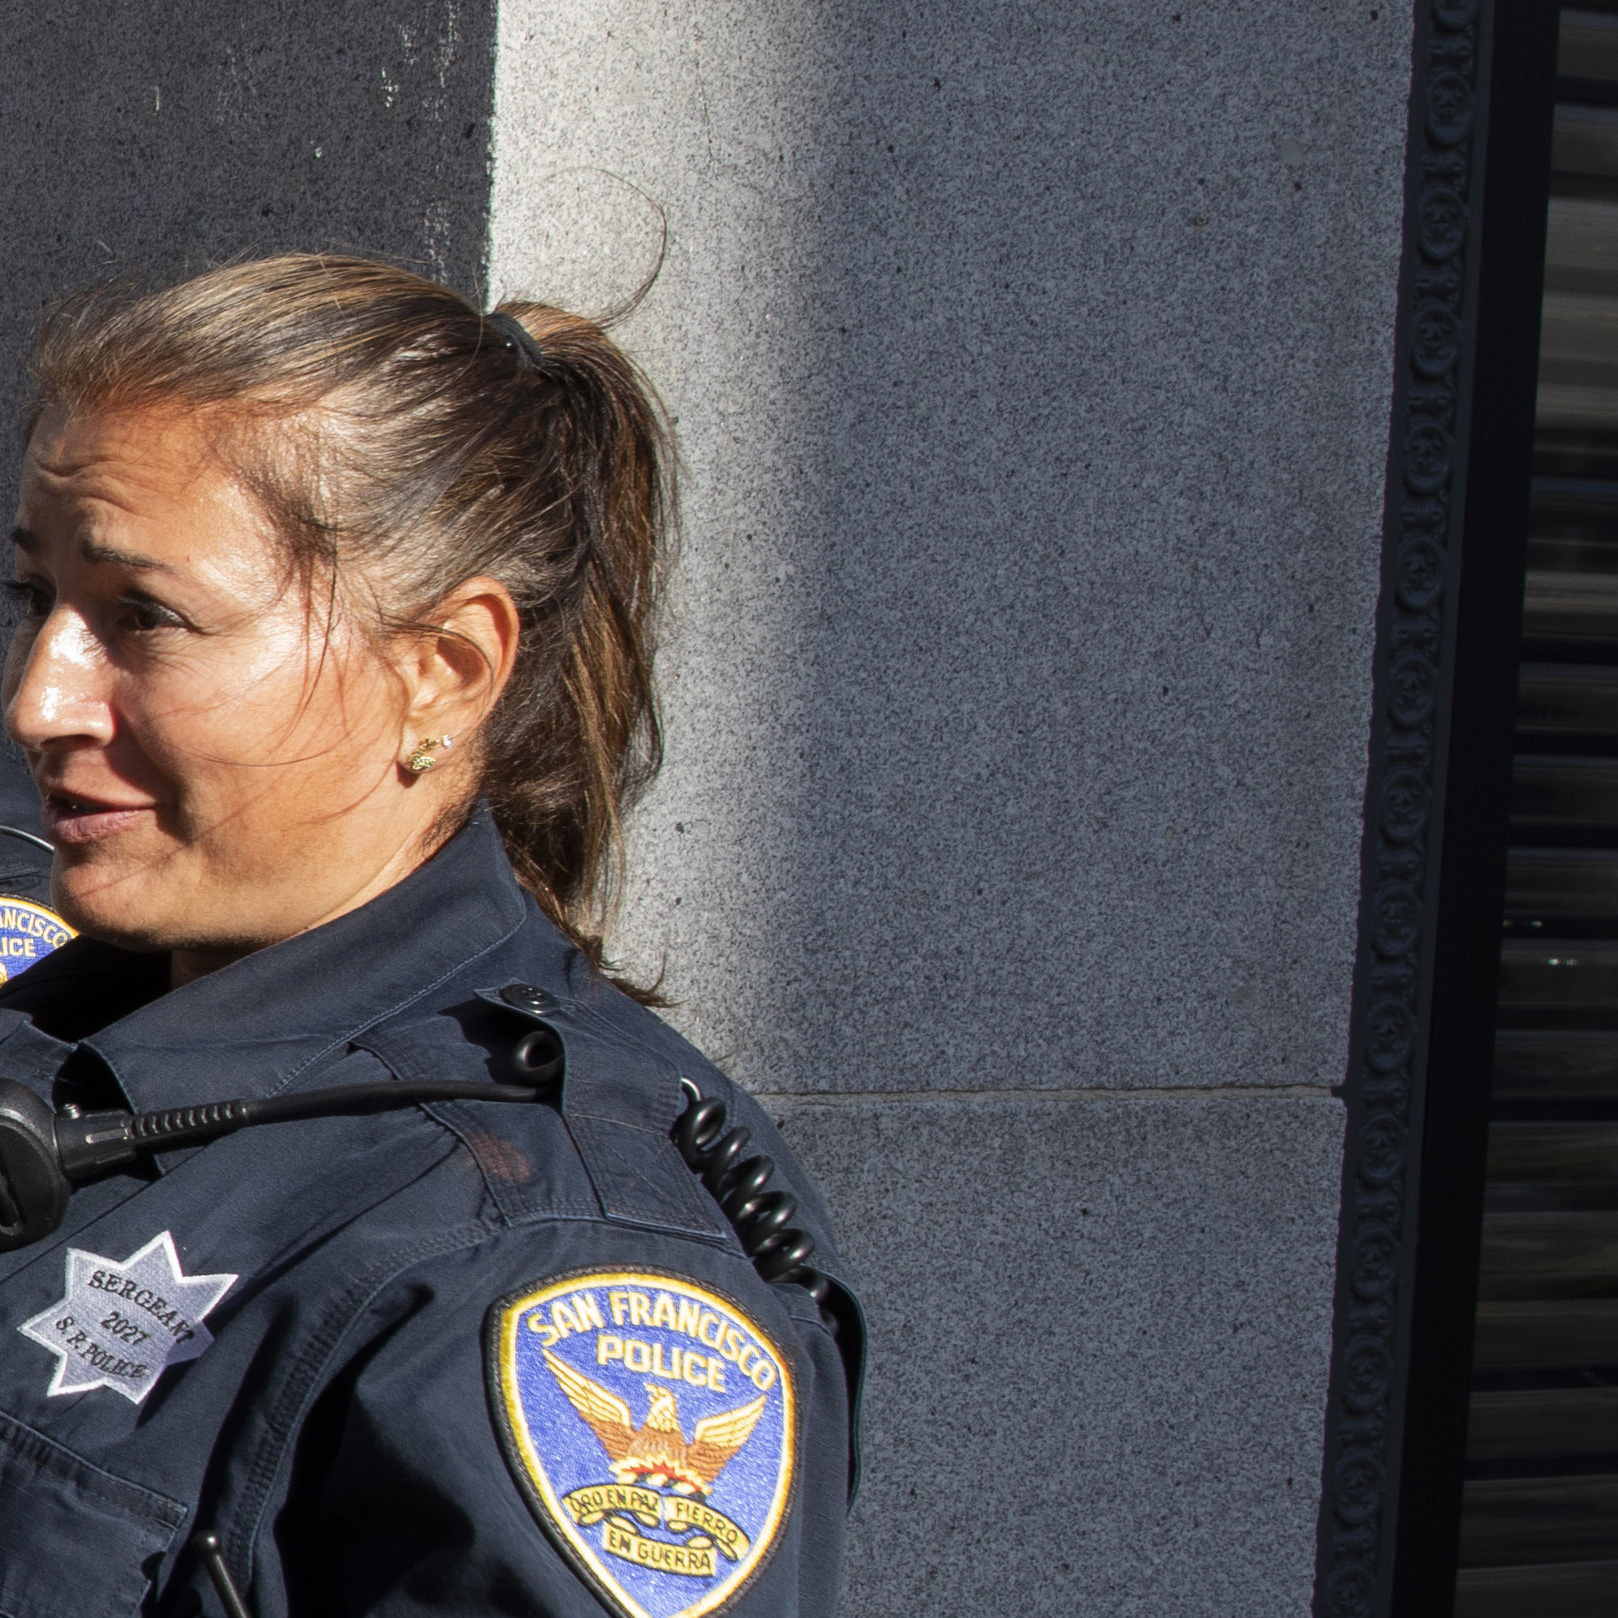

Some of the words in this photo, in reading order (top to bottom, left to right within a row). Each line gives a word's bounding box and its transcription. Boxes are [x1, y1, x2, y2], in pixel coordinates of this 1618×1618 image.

[88, 1270, 195, 1344] SERGEANT
[100, 1311, 150, 1346] 2027
[78, 1341, 148, 1378] POLICE
[527, 1293, 604, 1347] SAN
[608, 1291, 777, 1391] FRANCISCO
[597, 1334, 726, 1393] POLICE
[570, 1491, 604, 1514] ORO
[605, 1489, 627, 1506] EN
[630, 1490, 659, 1514] PAZ
[676, 1502, 739, 1544] FIERRO
[608, 1531, 632, 1550] EN
[637, 1541, 712, 1571] GUERRA
